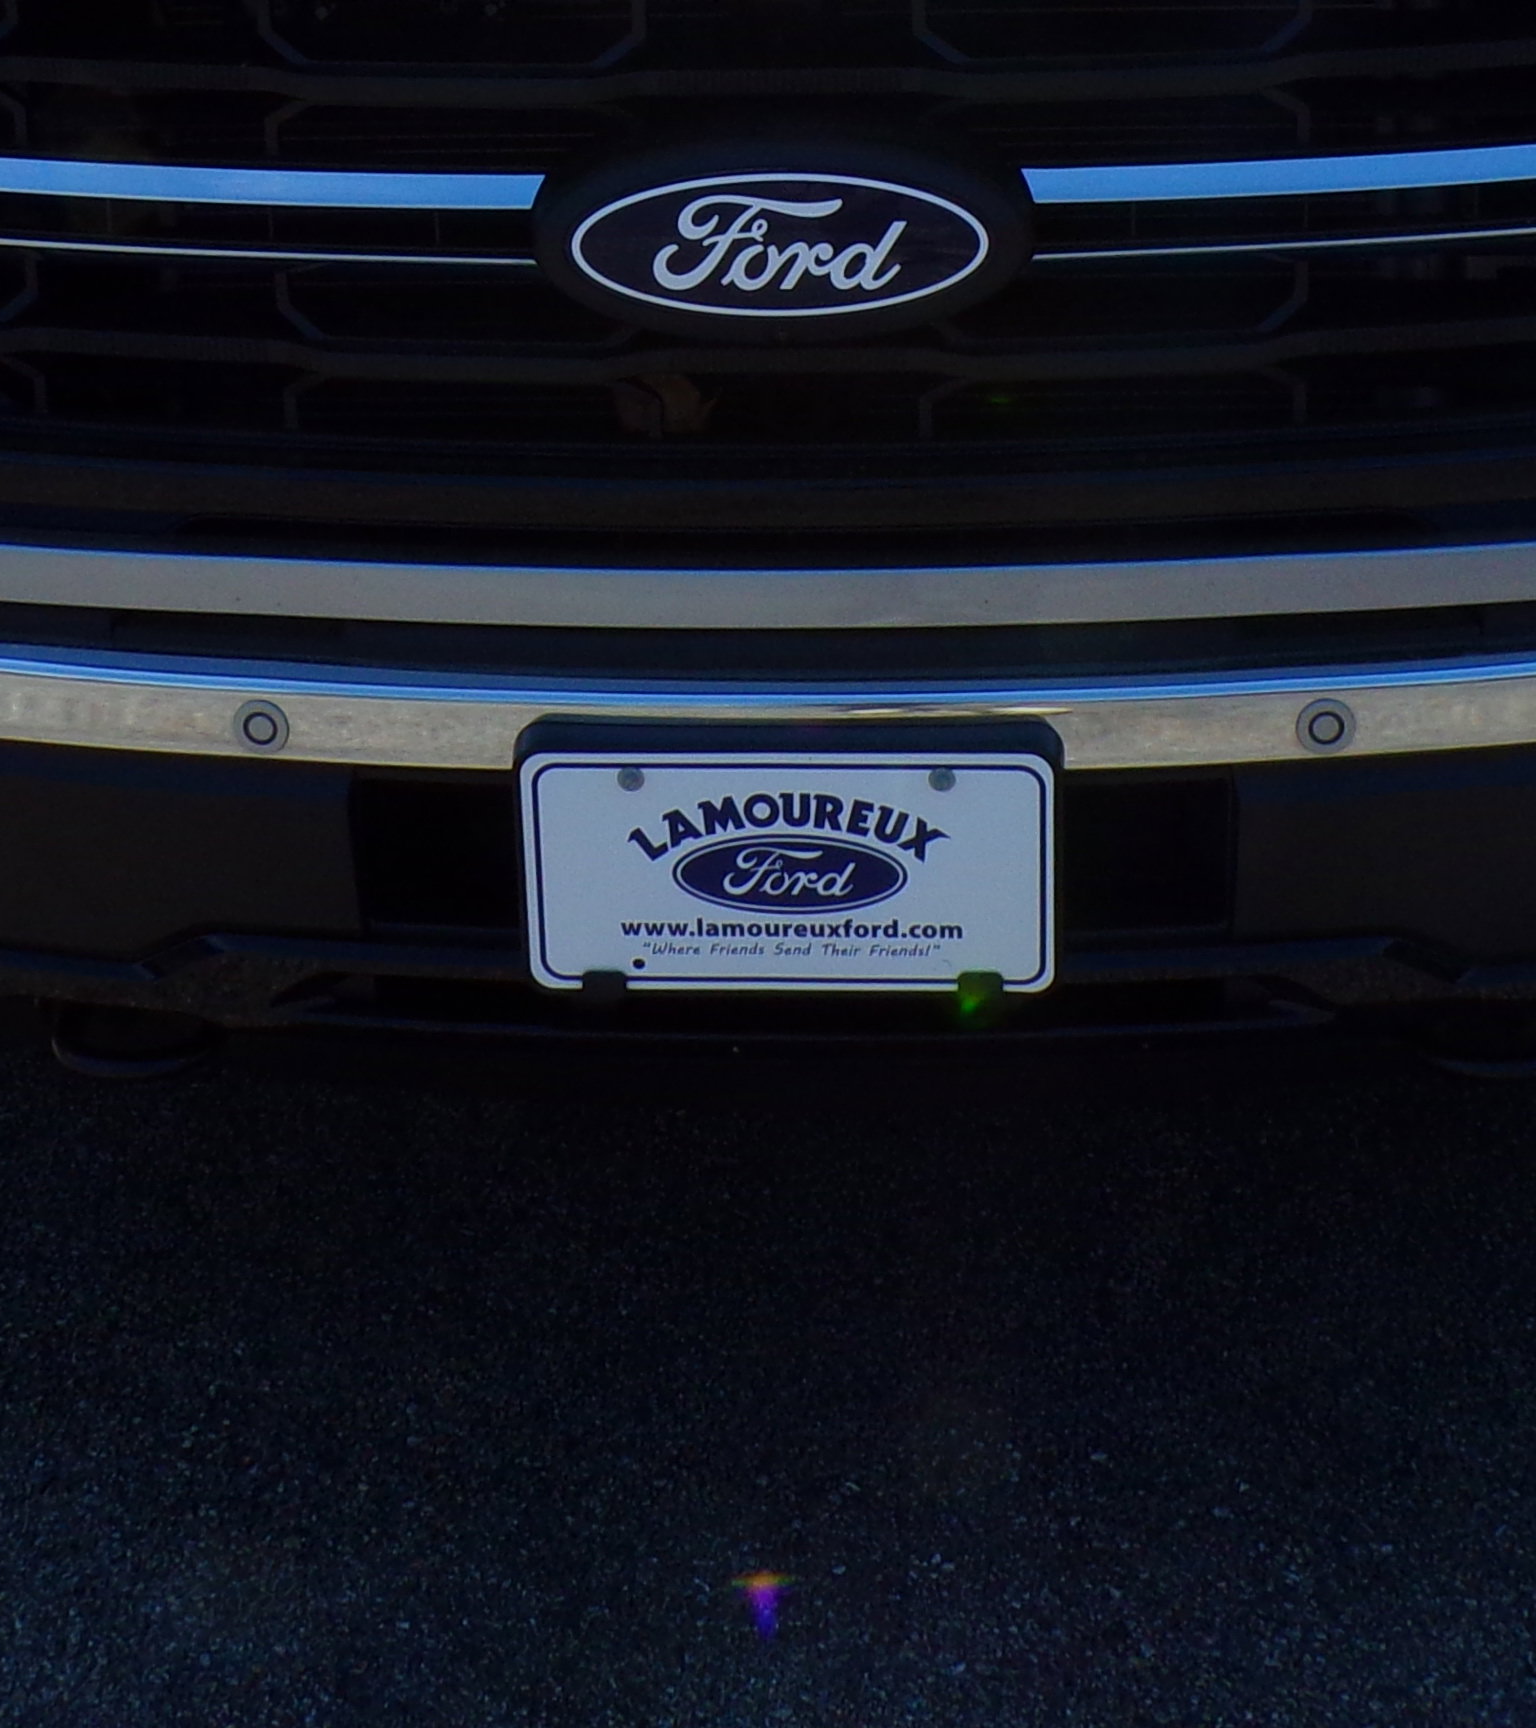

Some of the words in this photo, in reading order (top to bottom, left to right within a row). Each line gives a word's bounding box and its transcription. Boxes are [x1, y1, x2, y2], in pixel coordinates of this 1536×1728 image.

[653, 194, 908, 291] Ford
[627, 792, 952, 863] LAMOUREUX
[723, 845, 856, 897] Ford
[620, 918, 963, 939] www.lamoureuxford.com
[642, 942, 701, 956] "Where
[709, 942, 765, 957] Friends
[773, 942, 812, 957] Send
[822, 943, 861, 957] Their
[868, 944, 942, 958] Friends!"
